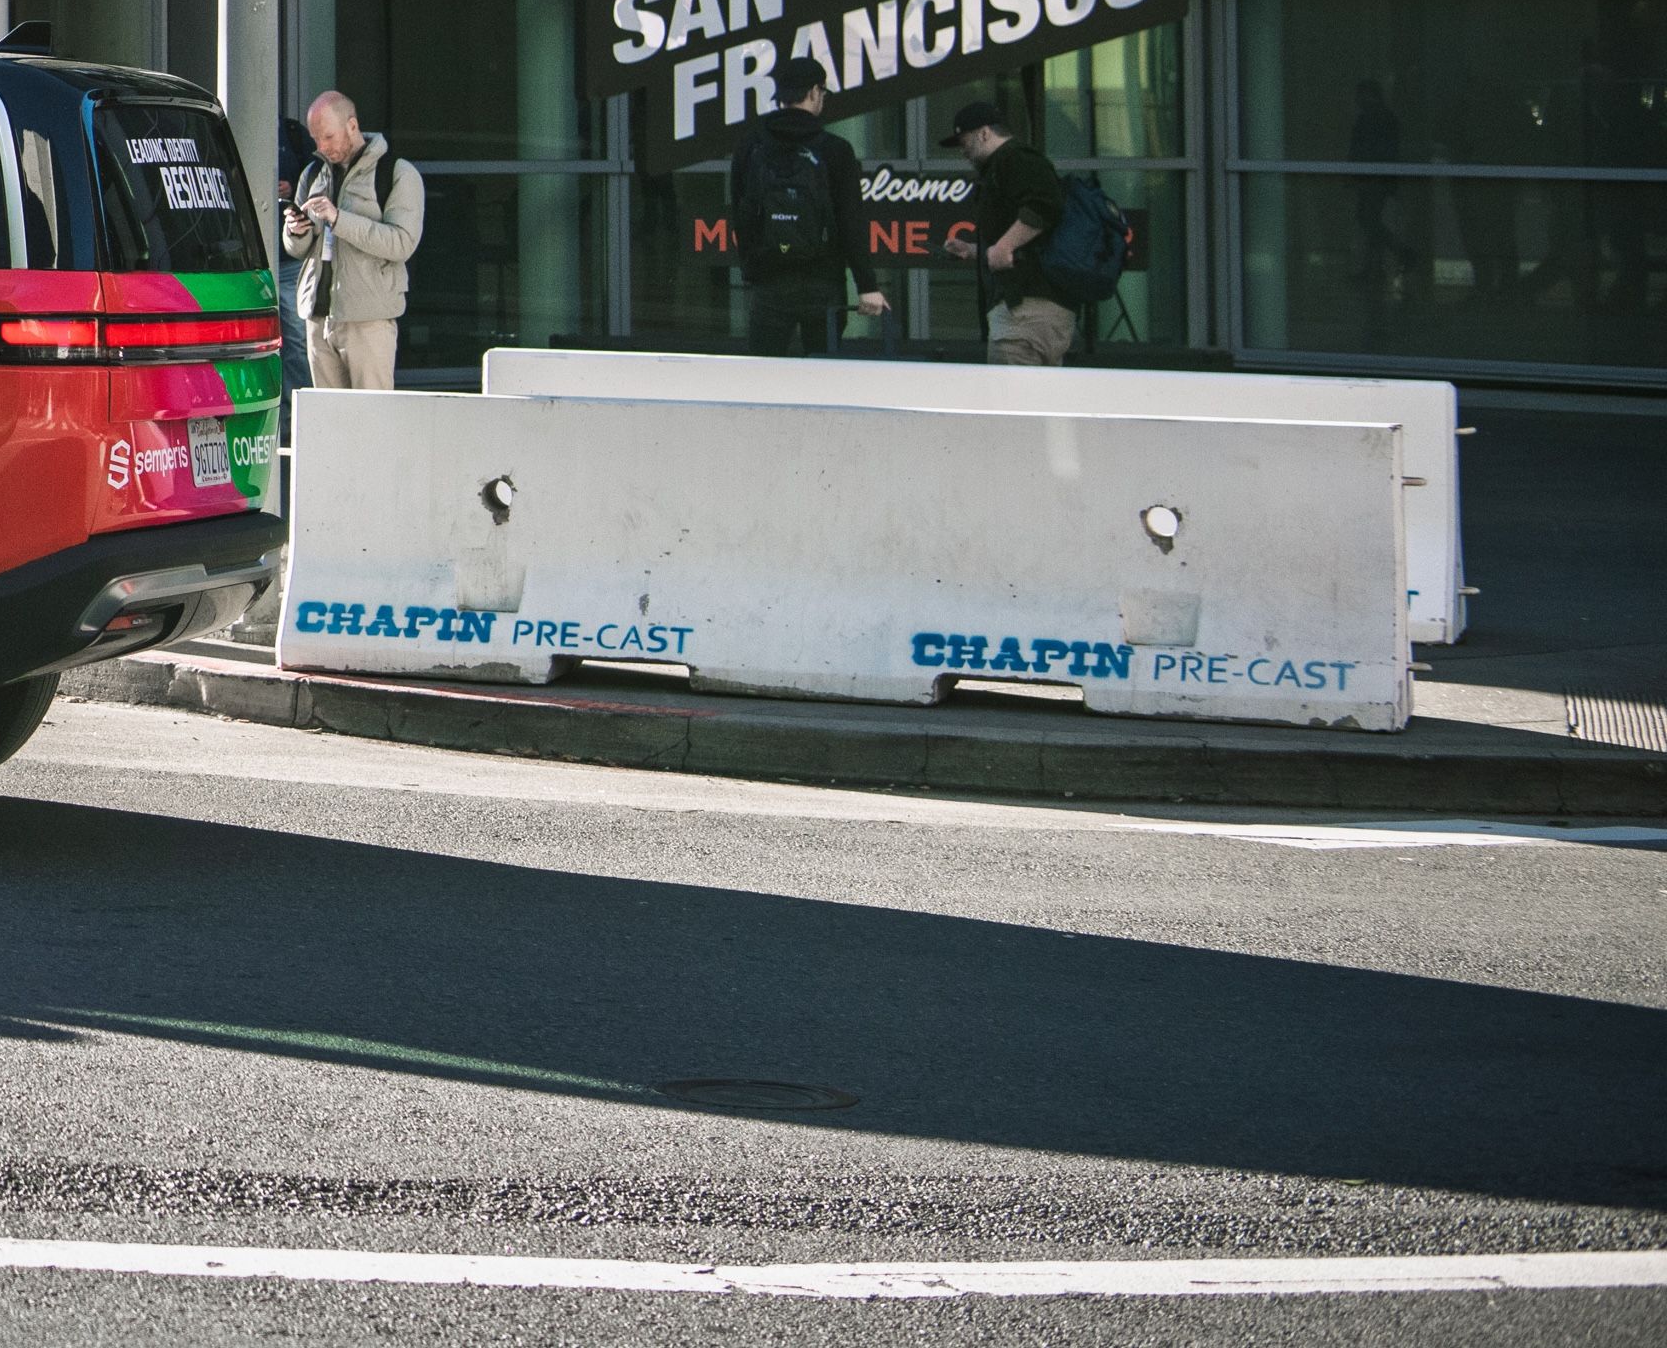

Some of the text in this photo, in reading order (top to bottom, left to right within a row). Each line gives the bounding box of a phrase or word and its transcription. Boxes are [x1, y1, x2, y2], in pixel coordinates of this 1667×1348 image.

[126, 138, 200, 164] LEADING IDENTITY
[159, 166, 231, 210] RESILIENCE
[860, 167, 974, 204] elcome
[135, 439, 189, 477] semperis
[295, 601, 694, 655] CHAPIN PRE-CAST
[911, 632, 1357, 693] CHAPIN PRE-CAST
